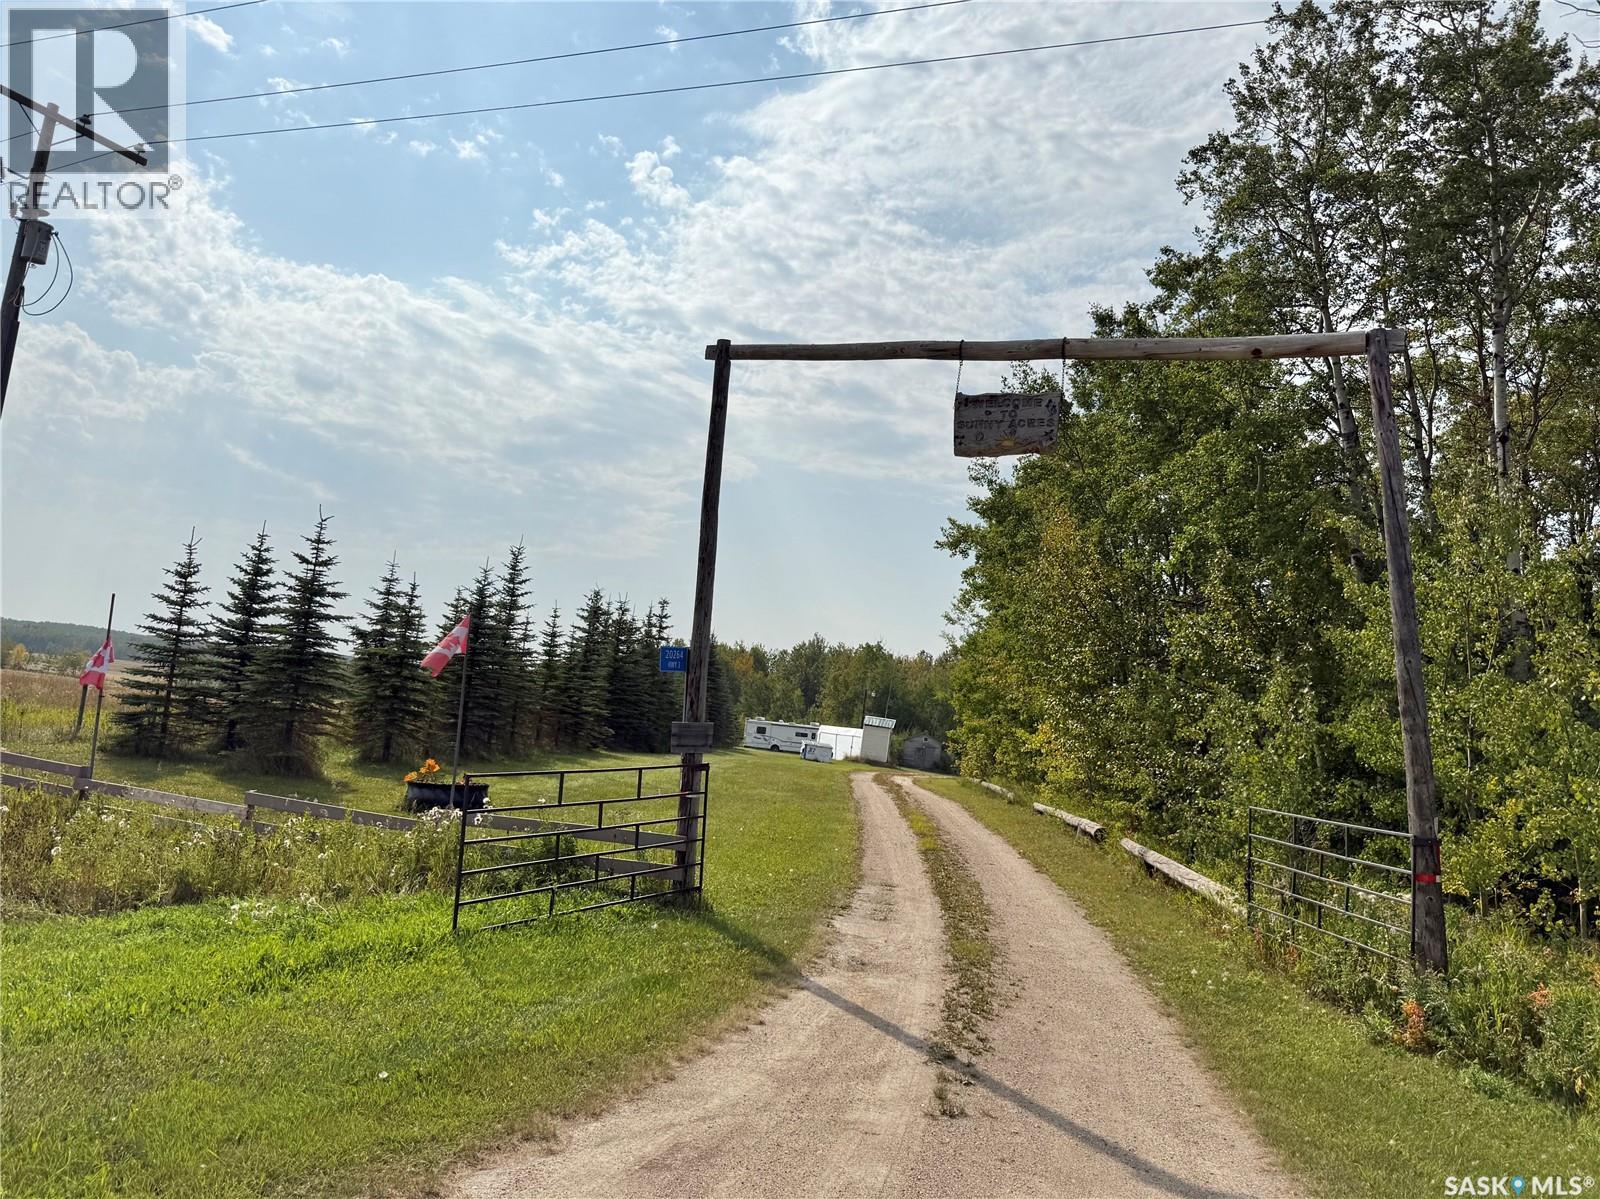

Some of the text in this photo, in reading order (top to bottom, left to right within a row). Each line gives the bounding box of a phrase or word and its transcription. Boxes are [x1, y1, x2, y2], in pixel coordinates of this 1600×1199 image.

[972, 398, 1043, 408] WELCOME
[1000, 409, 1018, 419] TO
[1007, 418, 1056, 429] ACRES
[664, 649, 683, 659] 20264
